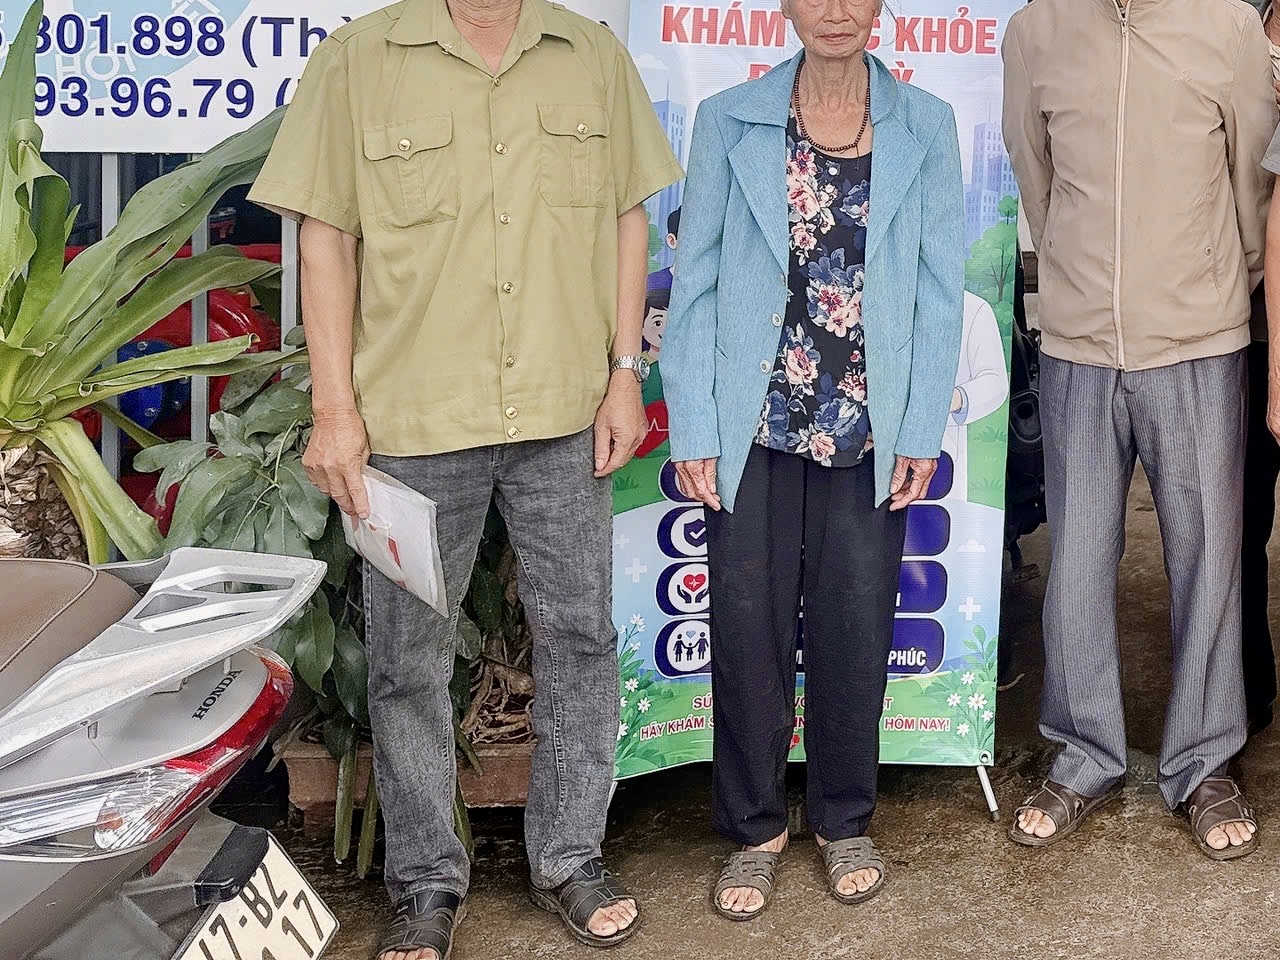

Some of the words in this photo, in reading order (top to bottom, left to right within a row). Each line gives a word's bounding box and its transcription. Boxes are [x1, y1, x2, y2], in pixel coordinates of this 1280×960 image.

[242, 16, 352, 68] (Th
[662, 1, 786, 47] KHÁM
[896, 7, 997, 54] KHỎE
[887, 647, 927, 667] PHÚC
[193, 668, 243, 721] HONDA
[641, 721, 664, 739] HÃY
[668, 715, 705, 733] KHÁM
[885, 715, 914, 730] HÔM
[919, 718, 950, 730] NAY!
